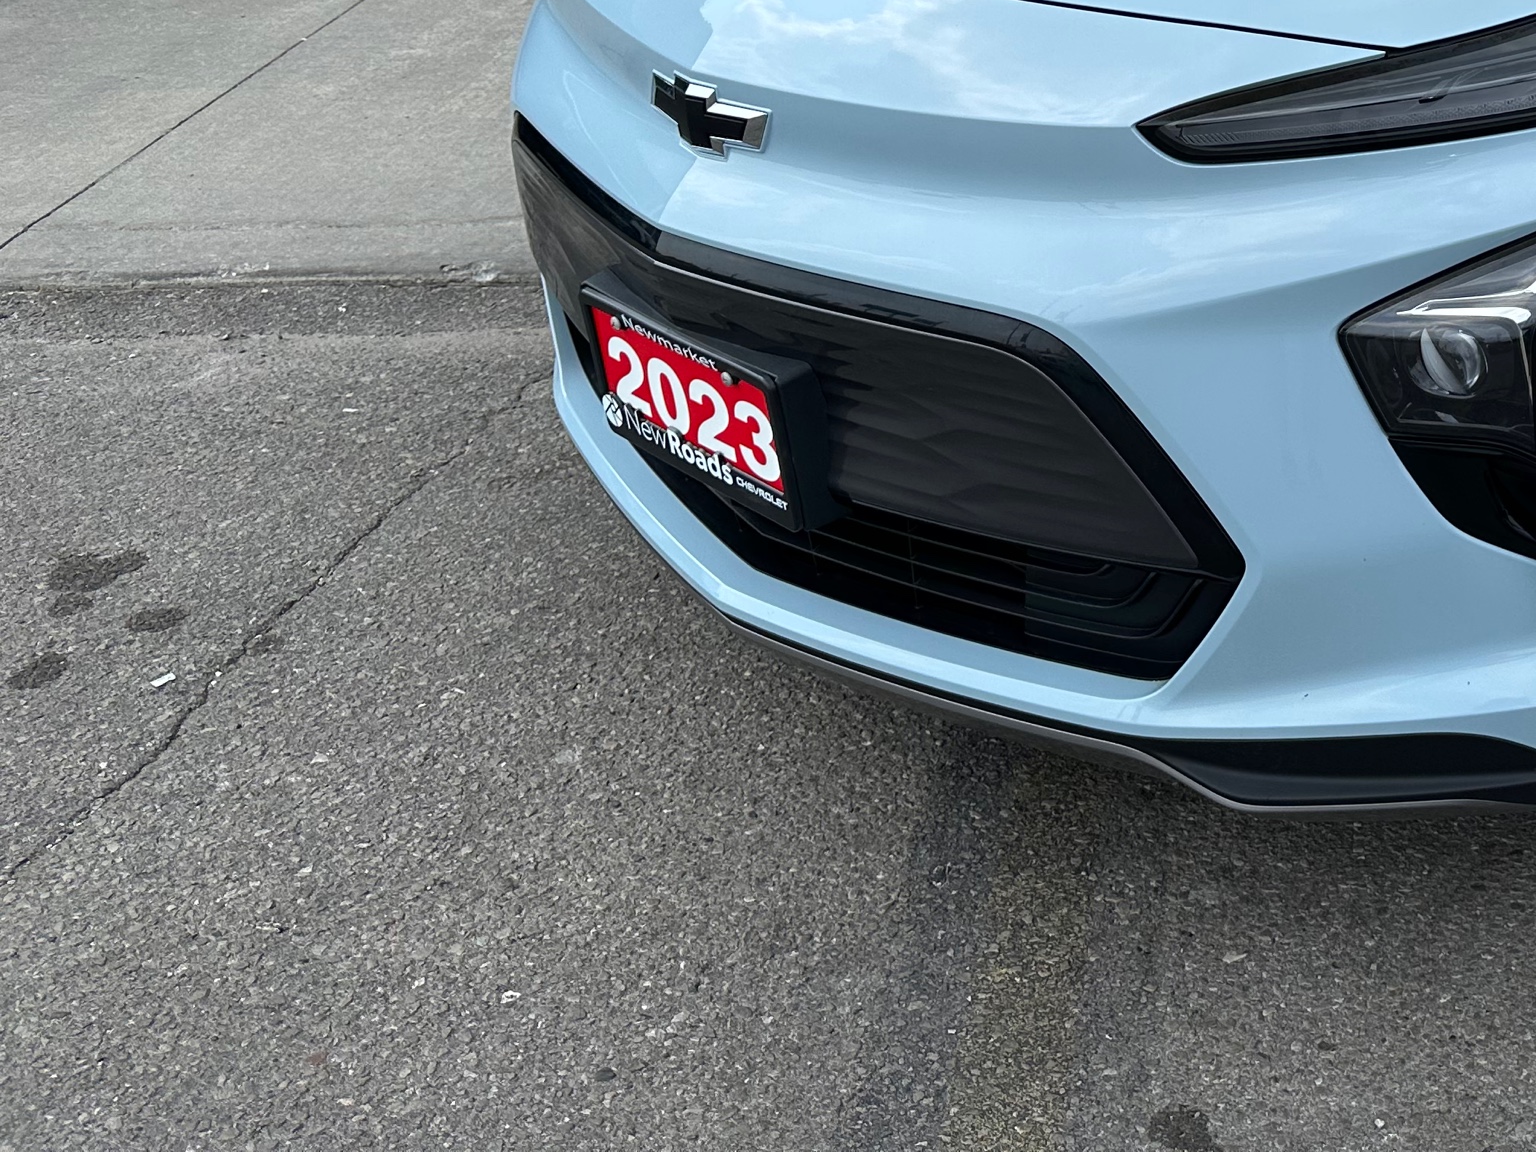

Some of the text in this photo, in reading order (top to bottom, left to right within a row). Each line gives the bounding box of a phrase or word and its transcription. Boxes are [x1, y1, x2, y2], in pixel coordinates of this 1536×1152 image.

[621, 313, 719, 372] Newmarket
[608, 335, 781, 483] 2023
[623, 406, 789, 511] NewRoads CHEVROLET
